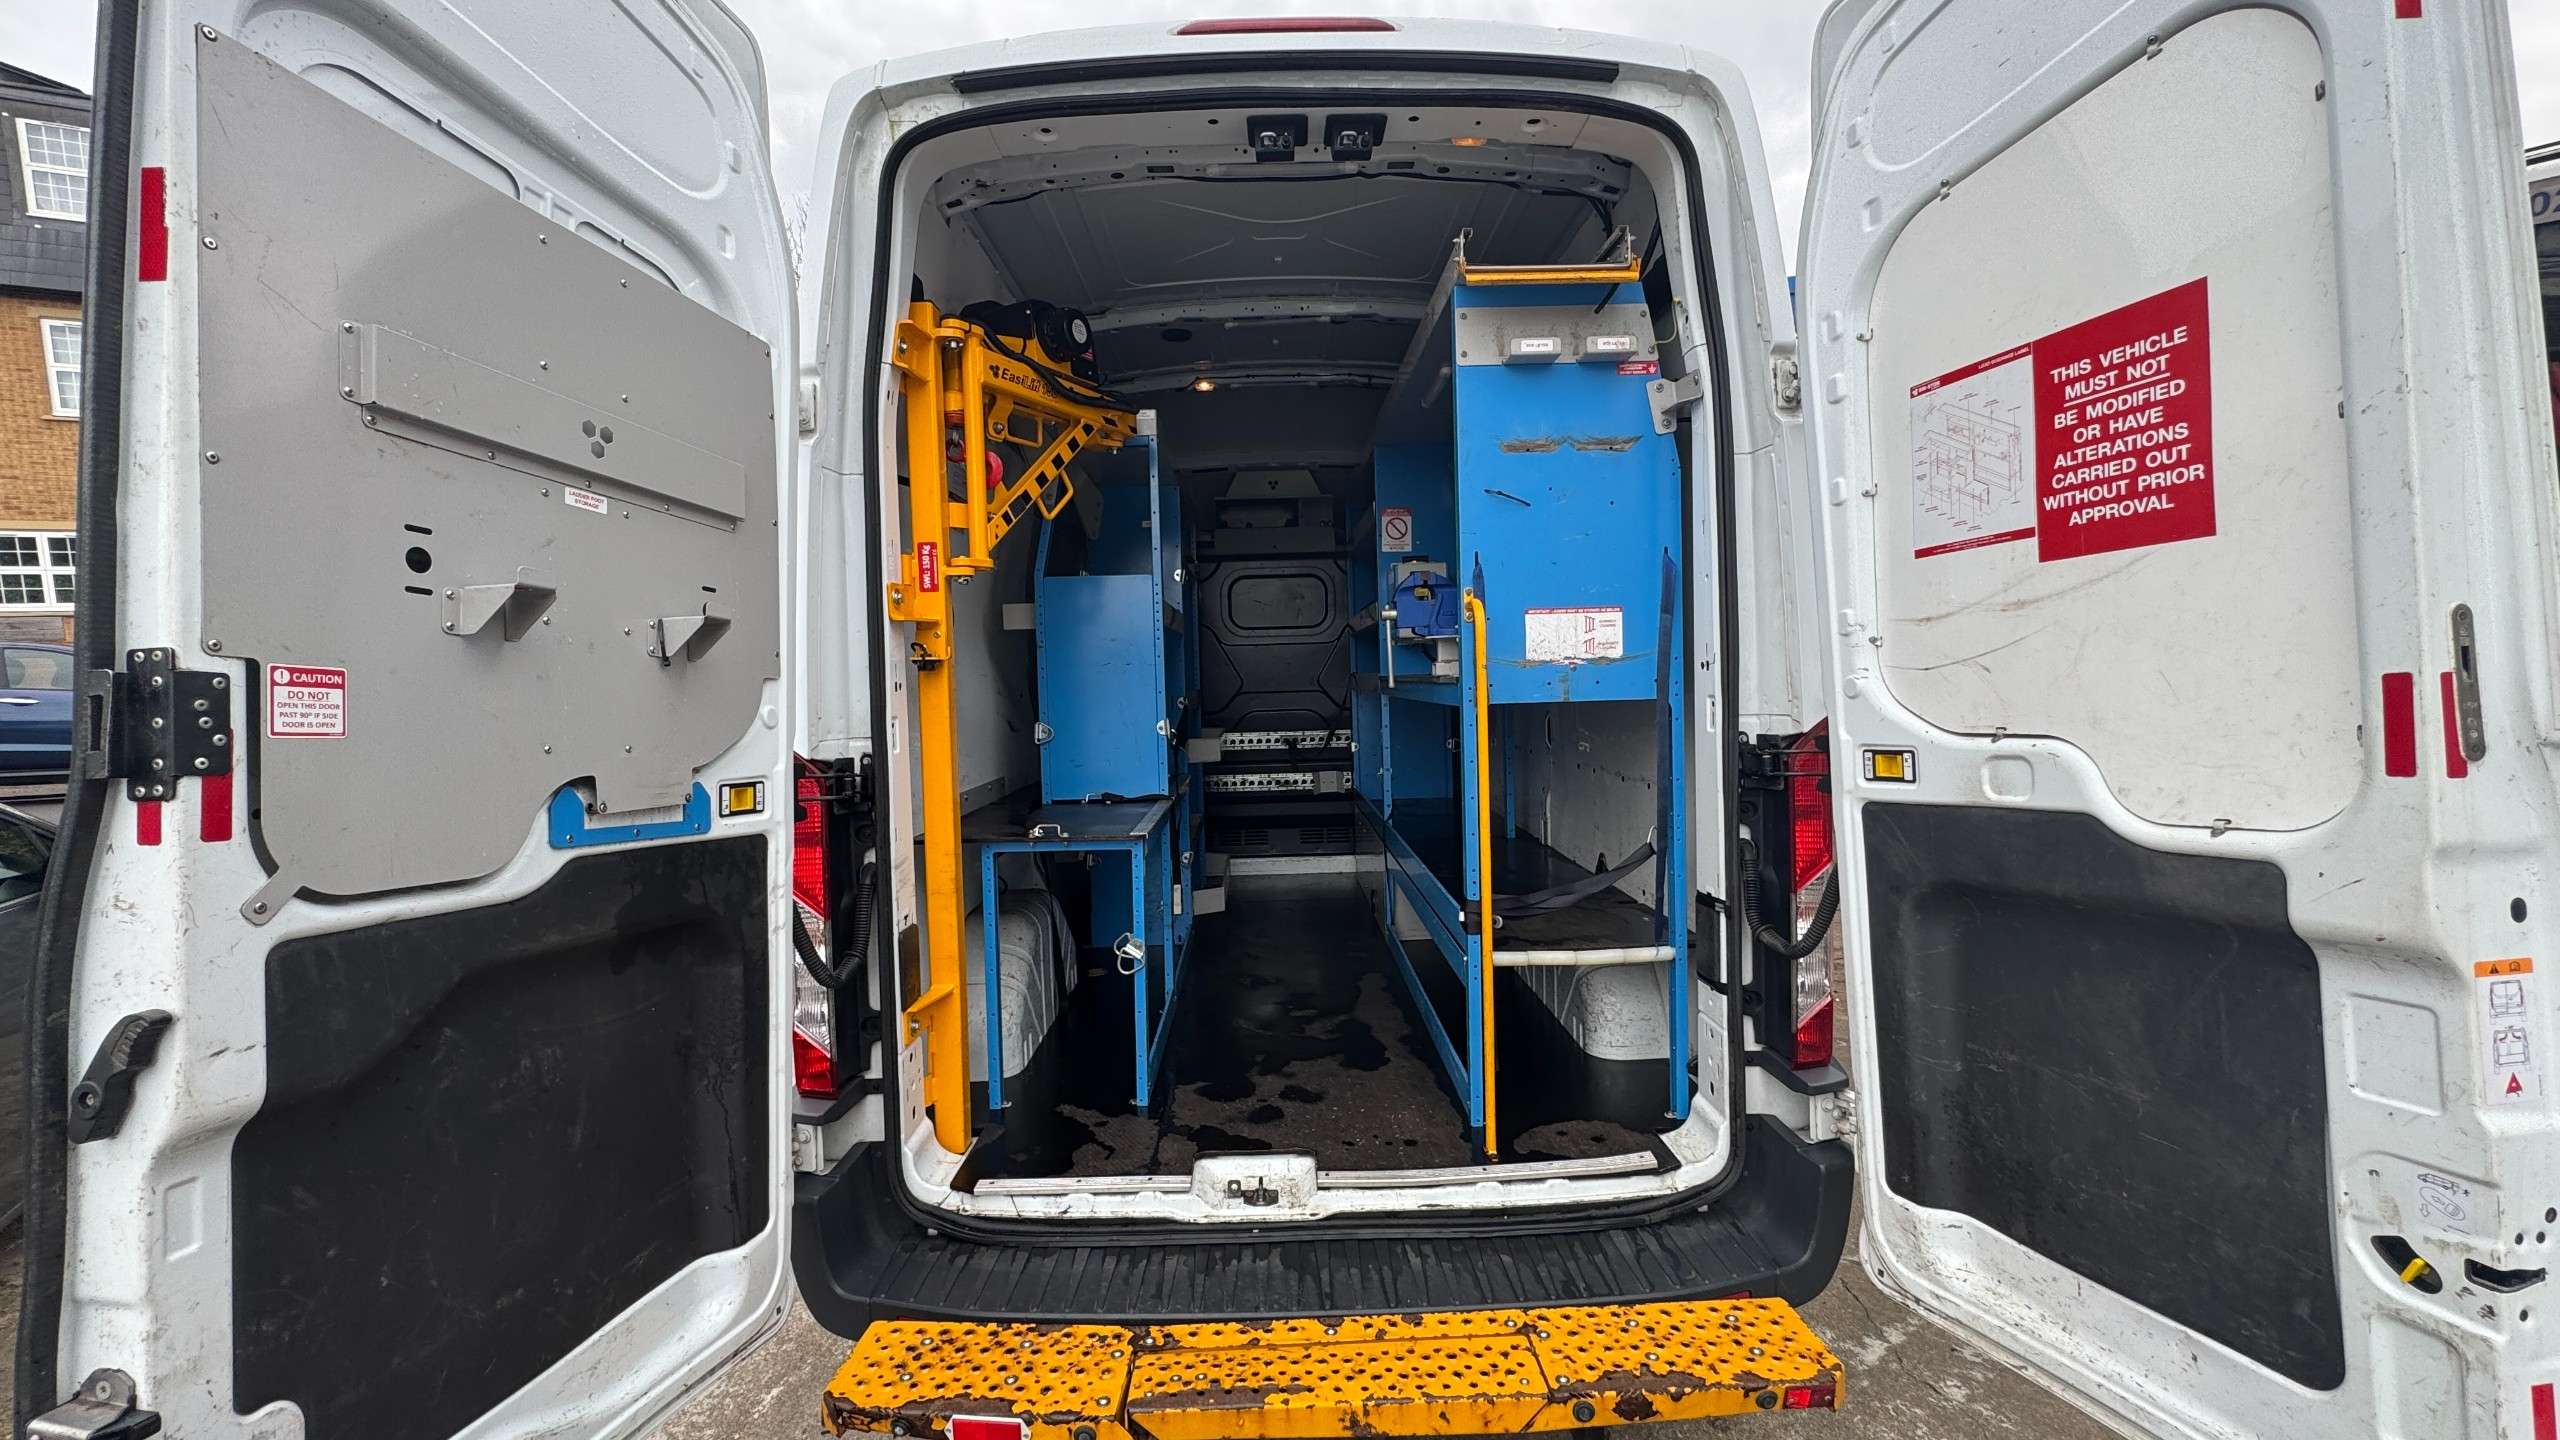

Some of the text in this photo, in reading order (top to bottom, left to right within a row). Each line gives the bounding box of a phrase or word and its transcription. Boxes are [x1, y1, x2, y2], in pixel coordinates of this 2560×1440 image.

[2050, 325, 2188, 384] THIS VEHICLE
[2065, 353, 2170, 400] MUST NOT
[2054, 379, 2186, 429] BE MODIFIED
[2073, 406, 2164, 443] OR HAVE
[2052, 443, 2191, 489] CARRIED OUT
[2054, 422, 2189, 469] ALTERATIONS
[2043, 464, 2205, 511] WITHOUT PRIOR
[2068, 493, 2175, 527] APPROVAL
[287, 690, 331, 701] DO NOT
[292, 673, 342, 685] CAUTION
[279, 711, 298, 719] PAST
[300, 702, 317, 710] THIS
